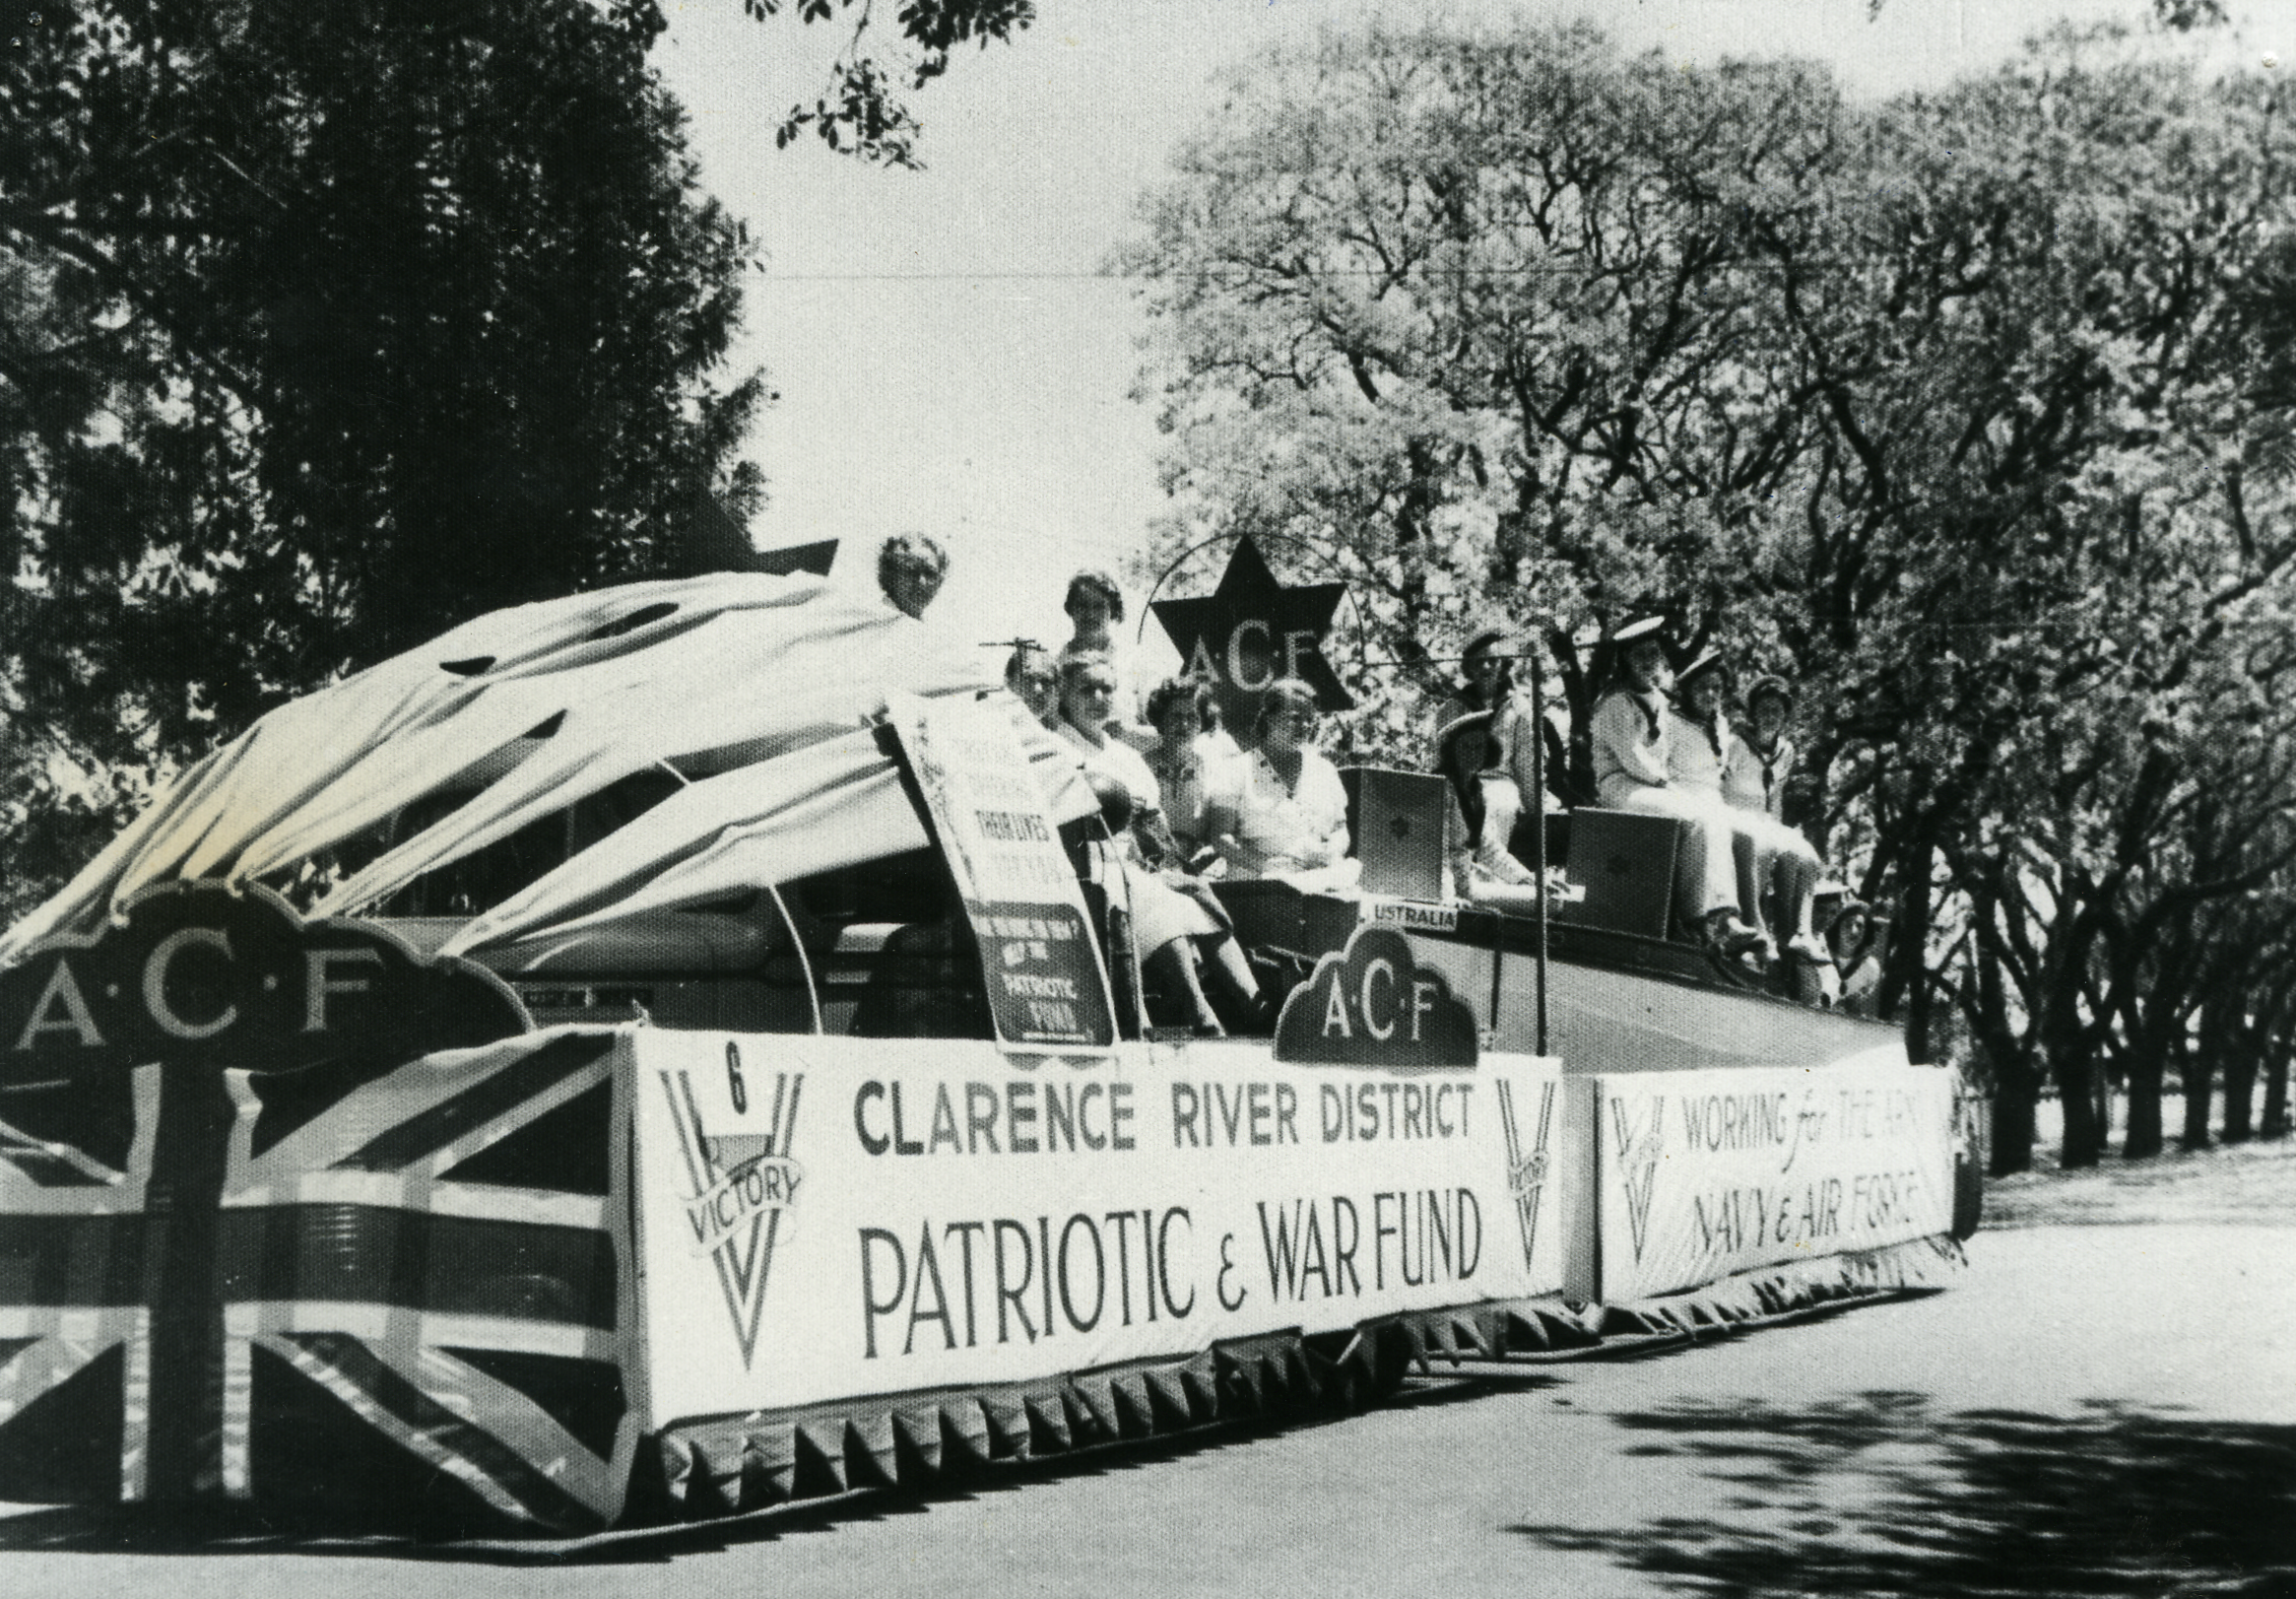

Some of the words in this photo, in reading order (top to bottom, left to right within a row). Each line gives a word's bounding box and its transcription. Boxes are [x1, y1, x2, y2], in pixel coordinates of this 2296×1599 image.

[1373, 903, 1455, 927] USTRALIA
[725, 1040, 748, 1115] 6
[854, 1080, 1137, 1156] CLARENCE
[1173, 1082, 1300, 1147] RIVER
[1320, 1082, 1476, 1144] DISTRICT
[1682, 1092, 1788, 1152] WORKING
[688, 1165, 803, 1243] VICTORY
[1797, 1176, 1844, 1245] AIR
[858, 1205, 1195, 1360] PATRIOTIC
[1216, 1232, 1248, 1312] &
[1256, 1195, 1362, 1304] WAR
[1373, 1187, 1482, 1291] FUND
